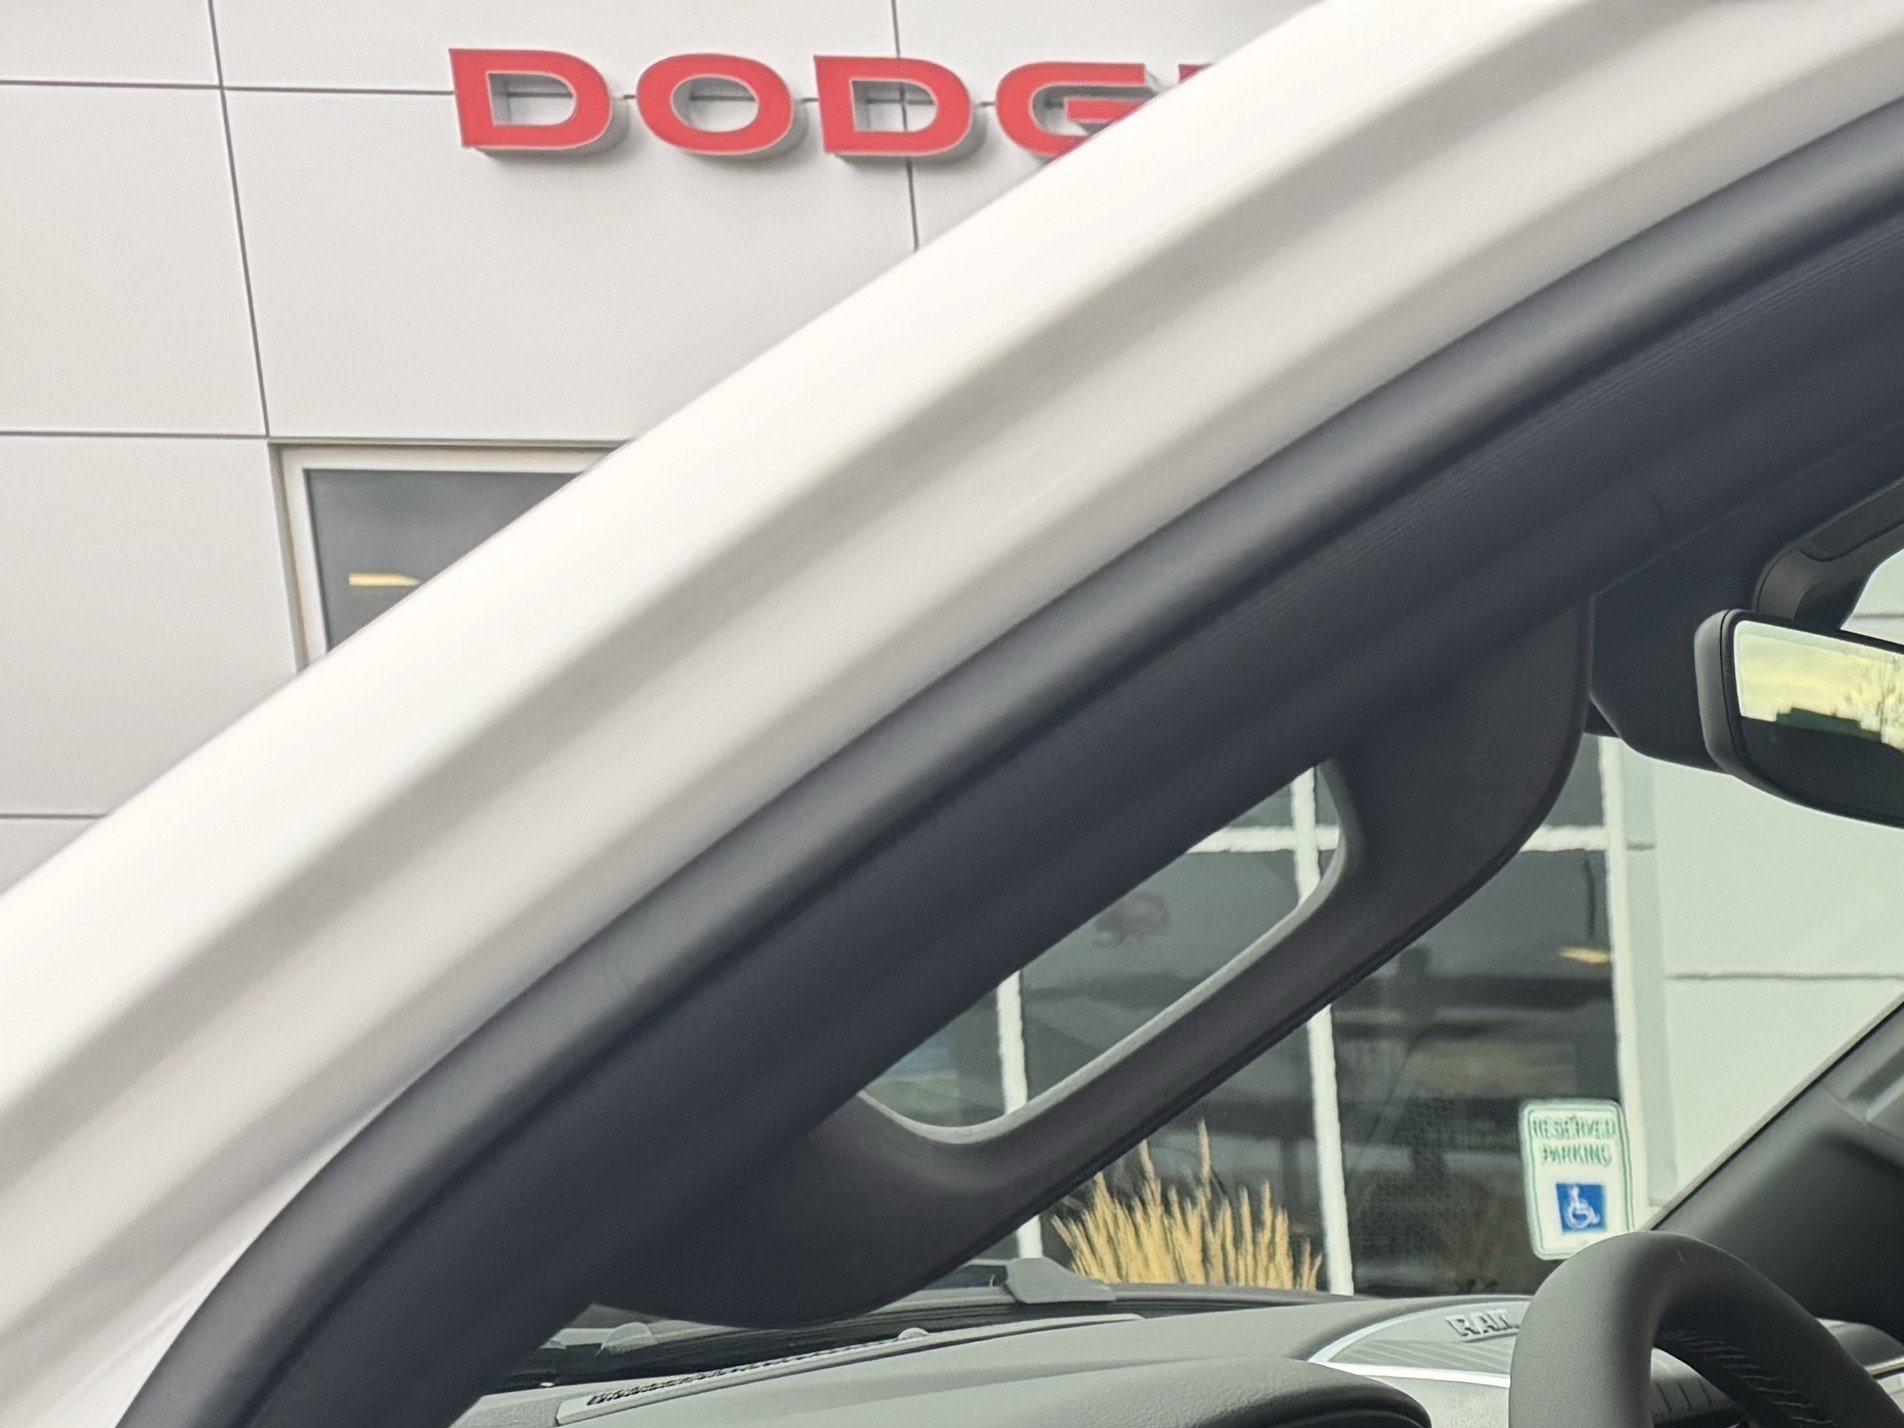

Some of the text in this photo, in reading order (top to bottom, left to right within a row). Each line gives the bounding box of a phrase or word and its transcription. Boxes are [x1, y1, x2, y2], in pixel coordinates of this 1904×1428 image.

[448, 47, 1214, 157] DODG
[1532, 1117, 1616, 1139] RESERVED
[1543, 1144, 1611, 1167] PARKING
